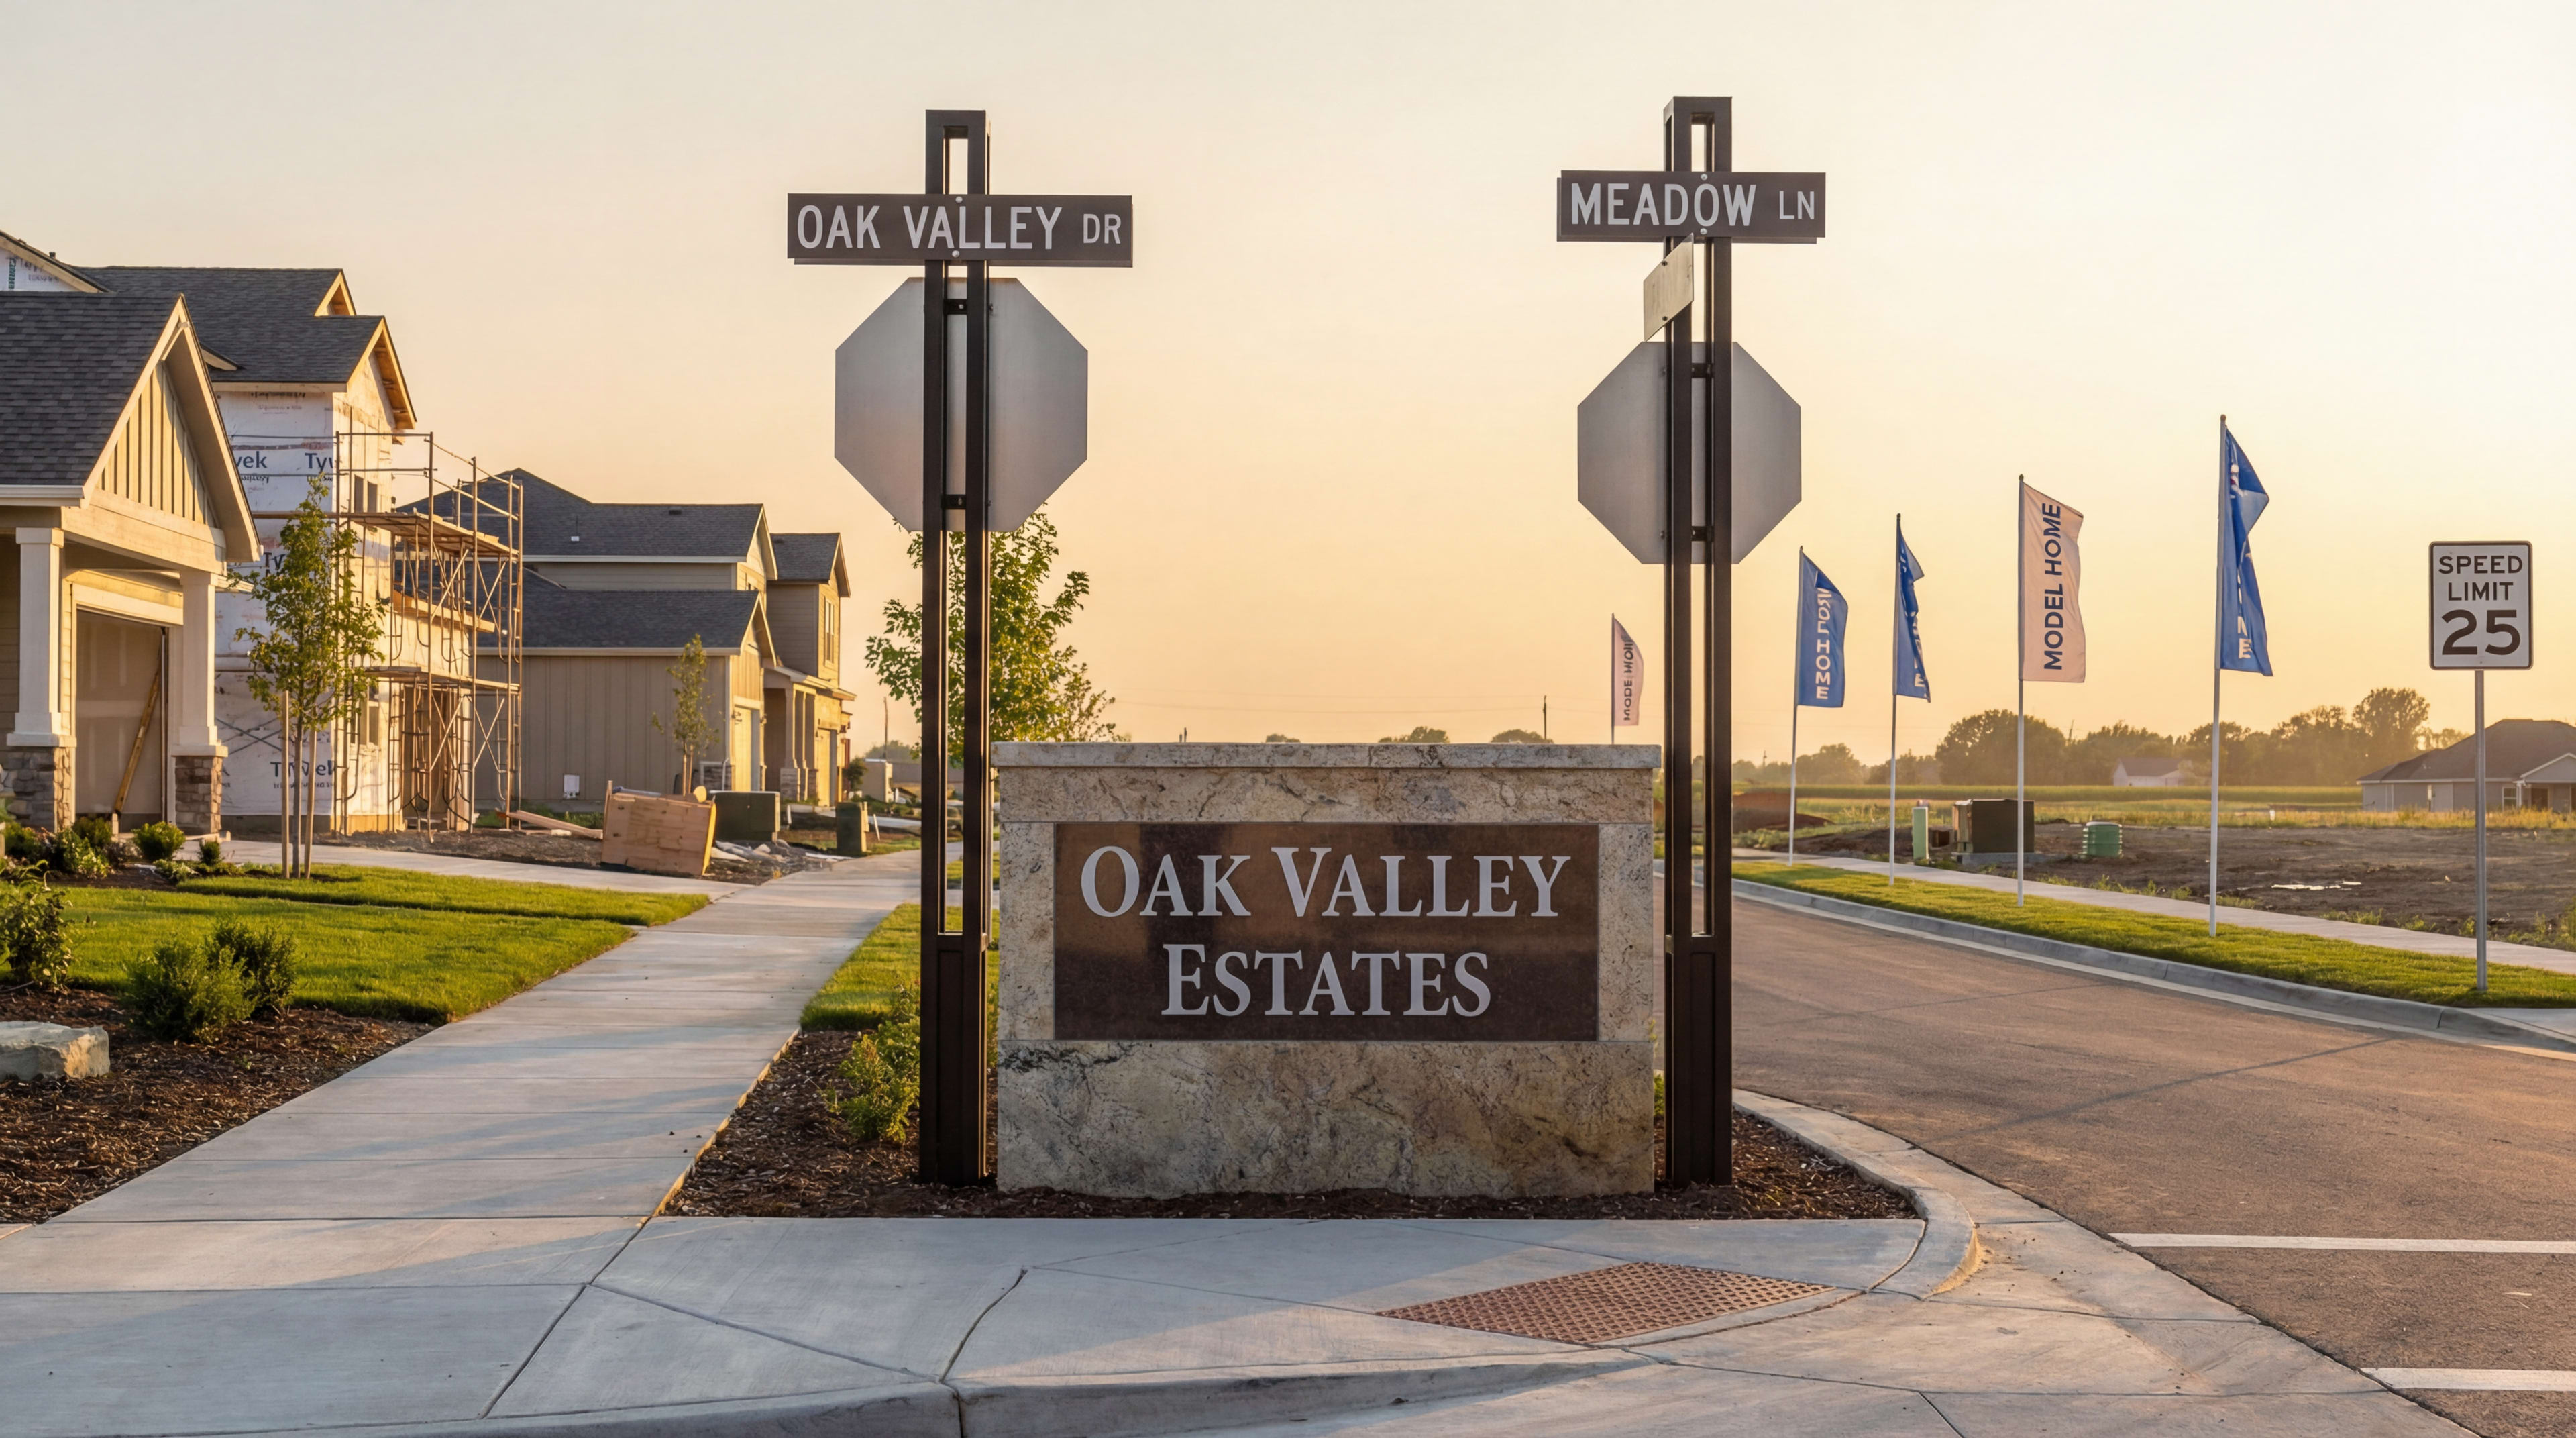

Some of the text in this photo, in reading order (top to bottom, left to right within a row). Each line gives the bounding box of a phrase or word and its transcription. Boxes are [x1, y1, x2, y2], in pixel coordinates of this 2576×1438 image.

[797, 205, 1122, 250] OAK VALLEY DR
[1571, 183, 1815, 227] MEADOW LN
[2041, 503, 2064, 670] MODEL HOME
[2438, 555, 2523, 574] SPEED
[2448, 582, 2514, 601] LIMIT
[2441, 609, 2521, 656] 25
[1815, 639, 1831, 700] HOME
[1081, 845, 1571, 918] OAK VALLEY
[1161, 944, 1491, 1017] ESTATES
